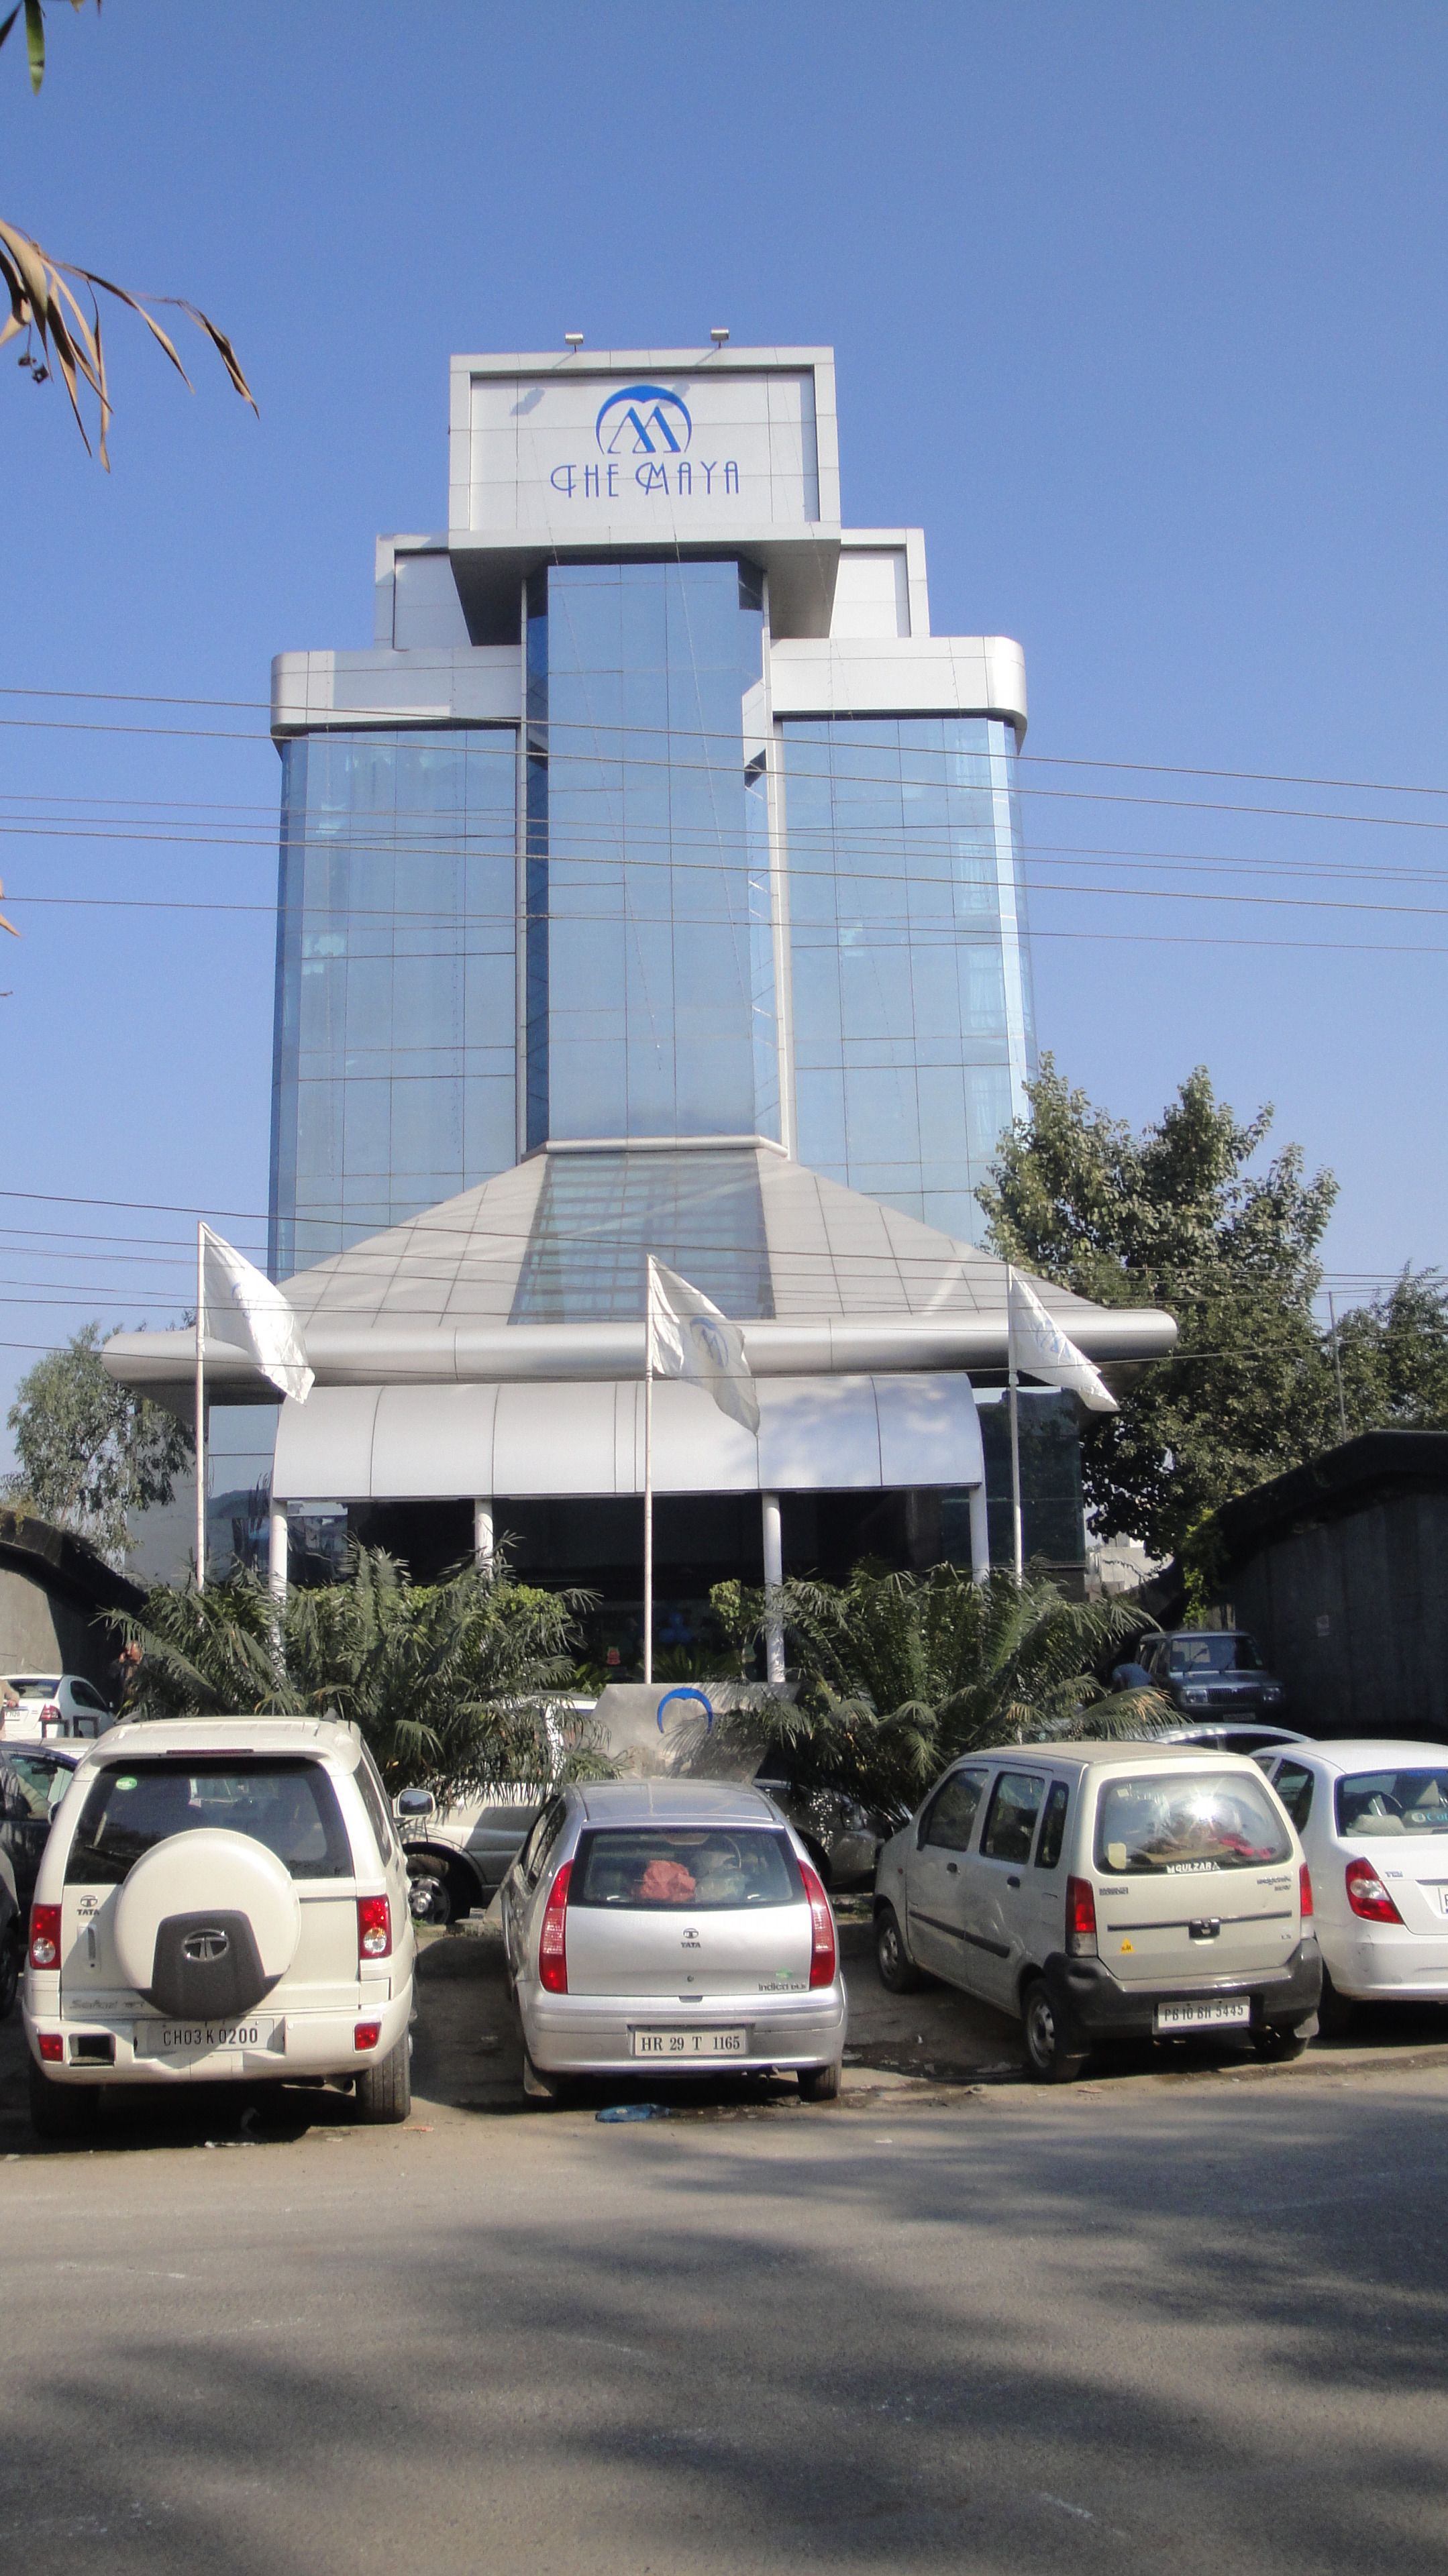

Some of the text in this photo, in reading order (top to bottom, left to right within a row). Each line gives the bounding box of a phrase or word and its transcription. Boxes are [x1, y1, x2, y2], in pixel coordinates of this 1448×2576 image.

[550, 461, 739, 498] THE MAYA
[1215, 2004, 1243, 2018] 5445
[219, 2027, 258, 2044] 0200
[641, 2035, 740, 2051] HR 29 T 1165
